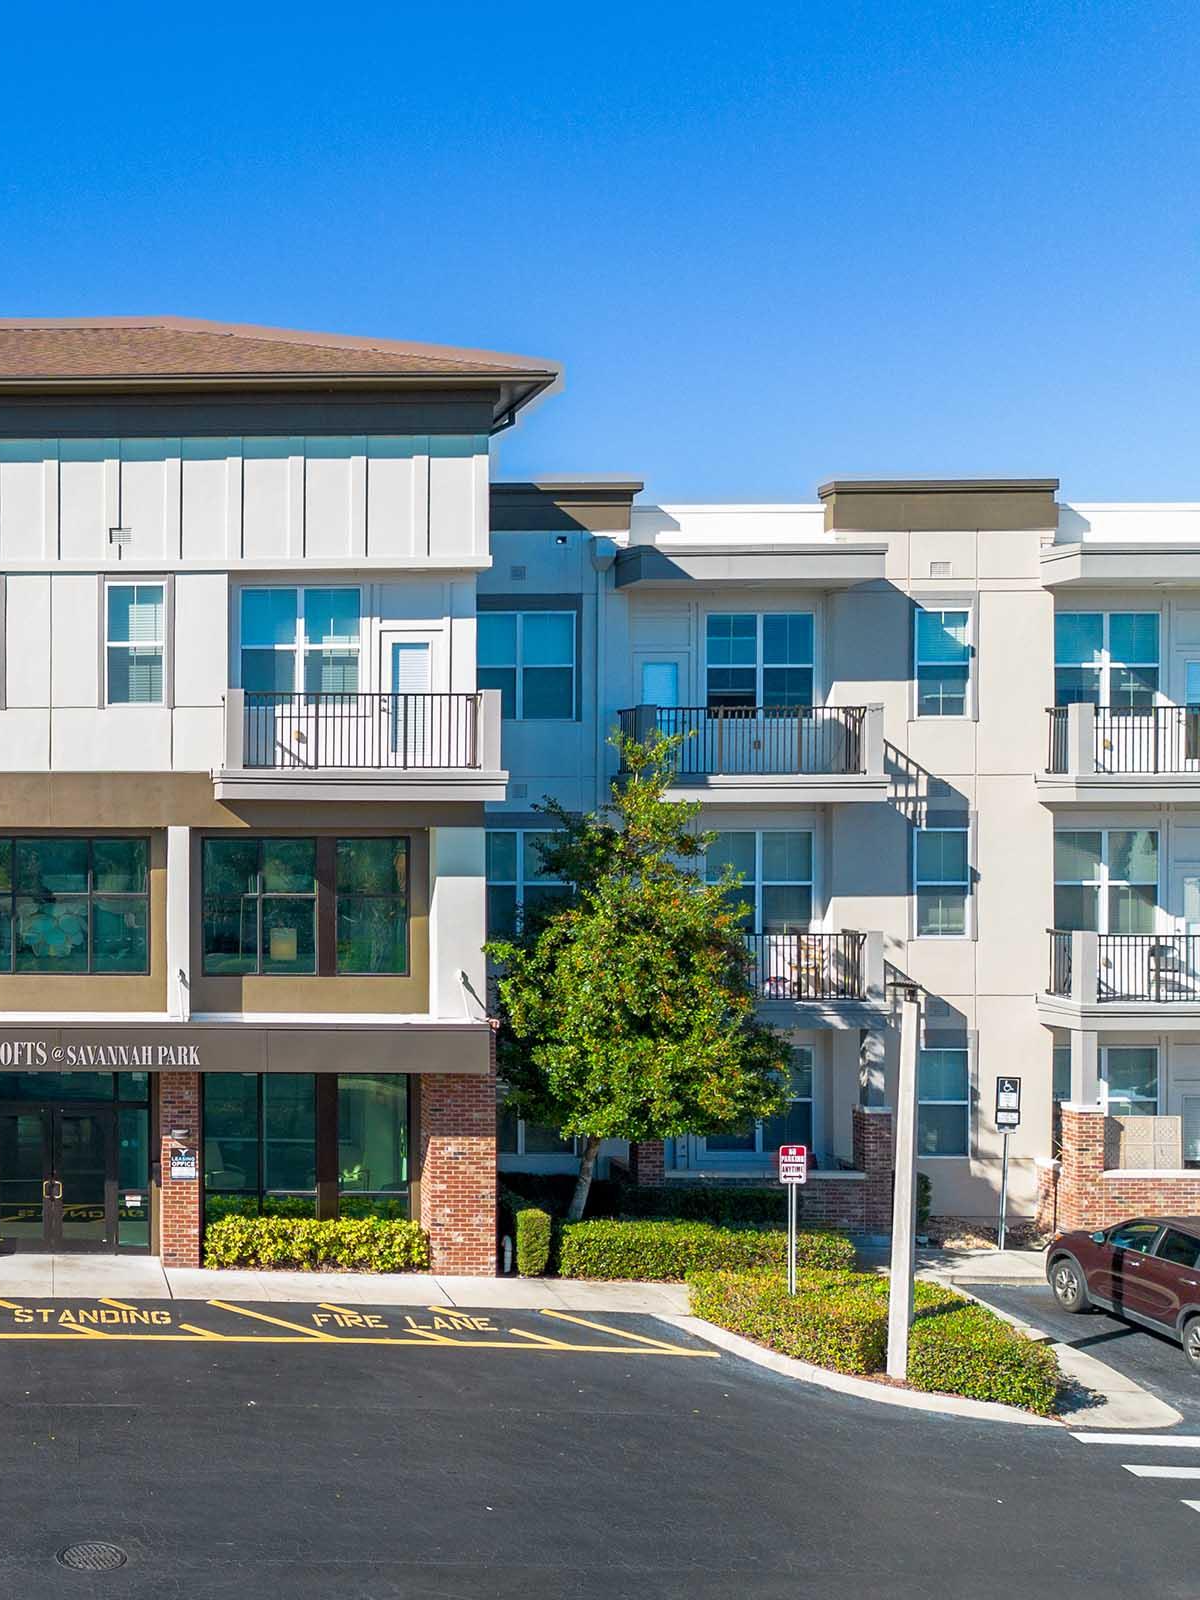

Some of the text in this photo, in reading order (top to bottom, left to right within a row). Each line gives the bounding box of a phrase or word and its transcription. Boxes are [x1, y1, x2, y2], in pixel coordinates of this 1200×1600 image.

[66, 1045, 152, 1066] SAVANNAH
[158, 1045, 200, 1066] PARK
[13, 1308, 172, 1324] STANDING
[311, 1313, 389, 1329] FIRE
[404, 1315, 498, 1331] LANE
